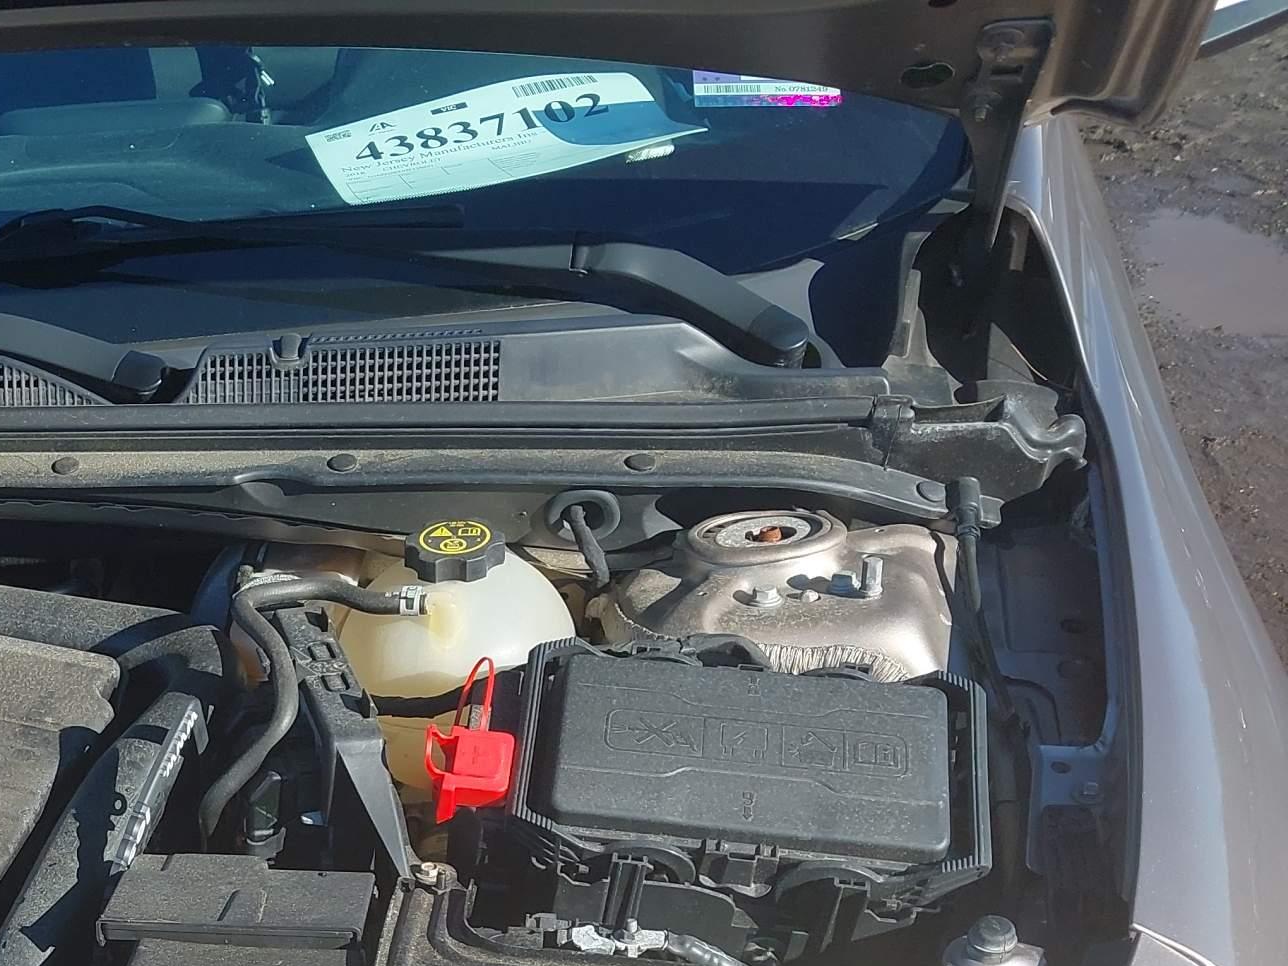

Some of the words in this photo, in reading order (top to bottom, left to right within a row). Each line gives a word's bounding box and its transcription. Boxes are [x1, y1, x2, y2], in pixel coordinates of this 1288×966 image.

[355, 92, 609, 160] 43837102
[341, 165, 372, 173] New
[375, 156, 415, 168] Jersey
[420, 136, 514, 159] Manufacturers
